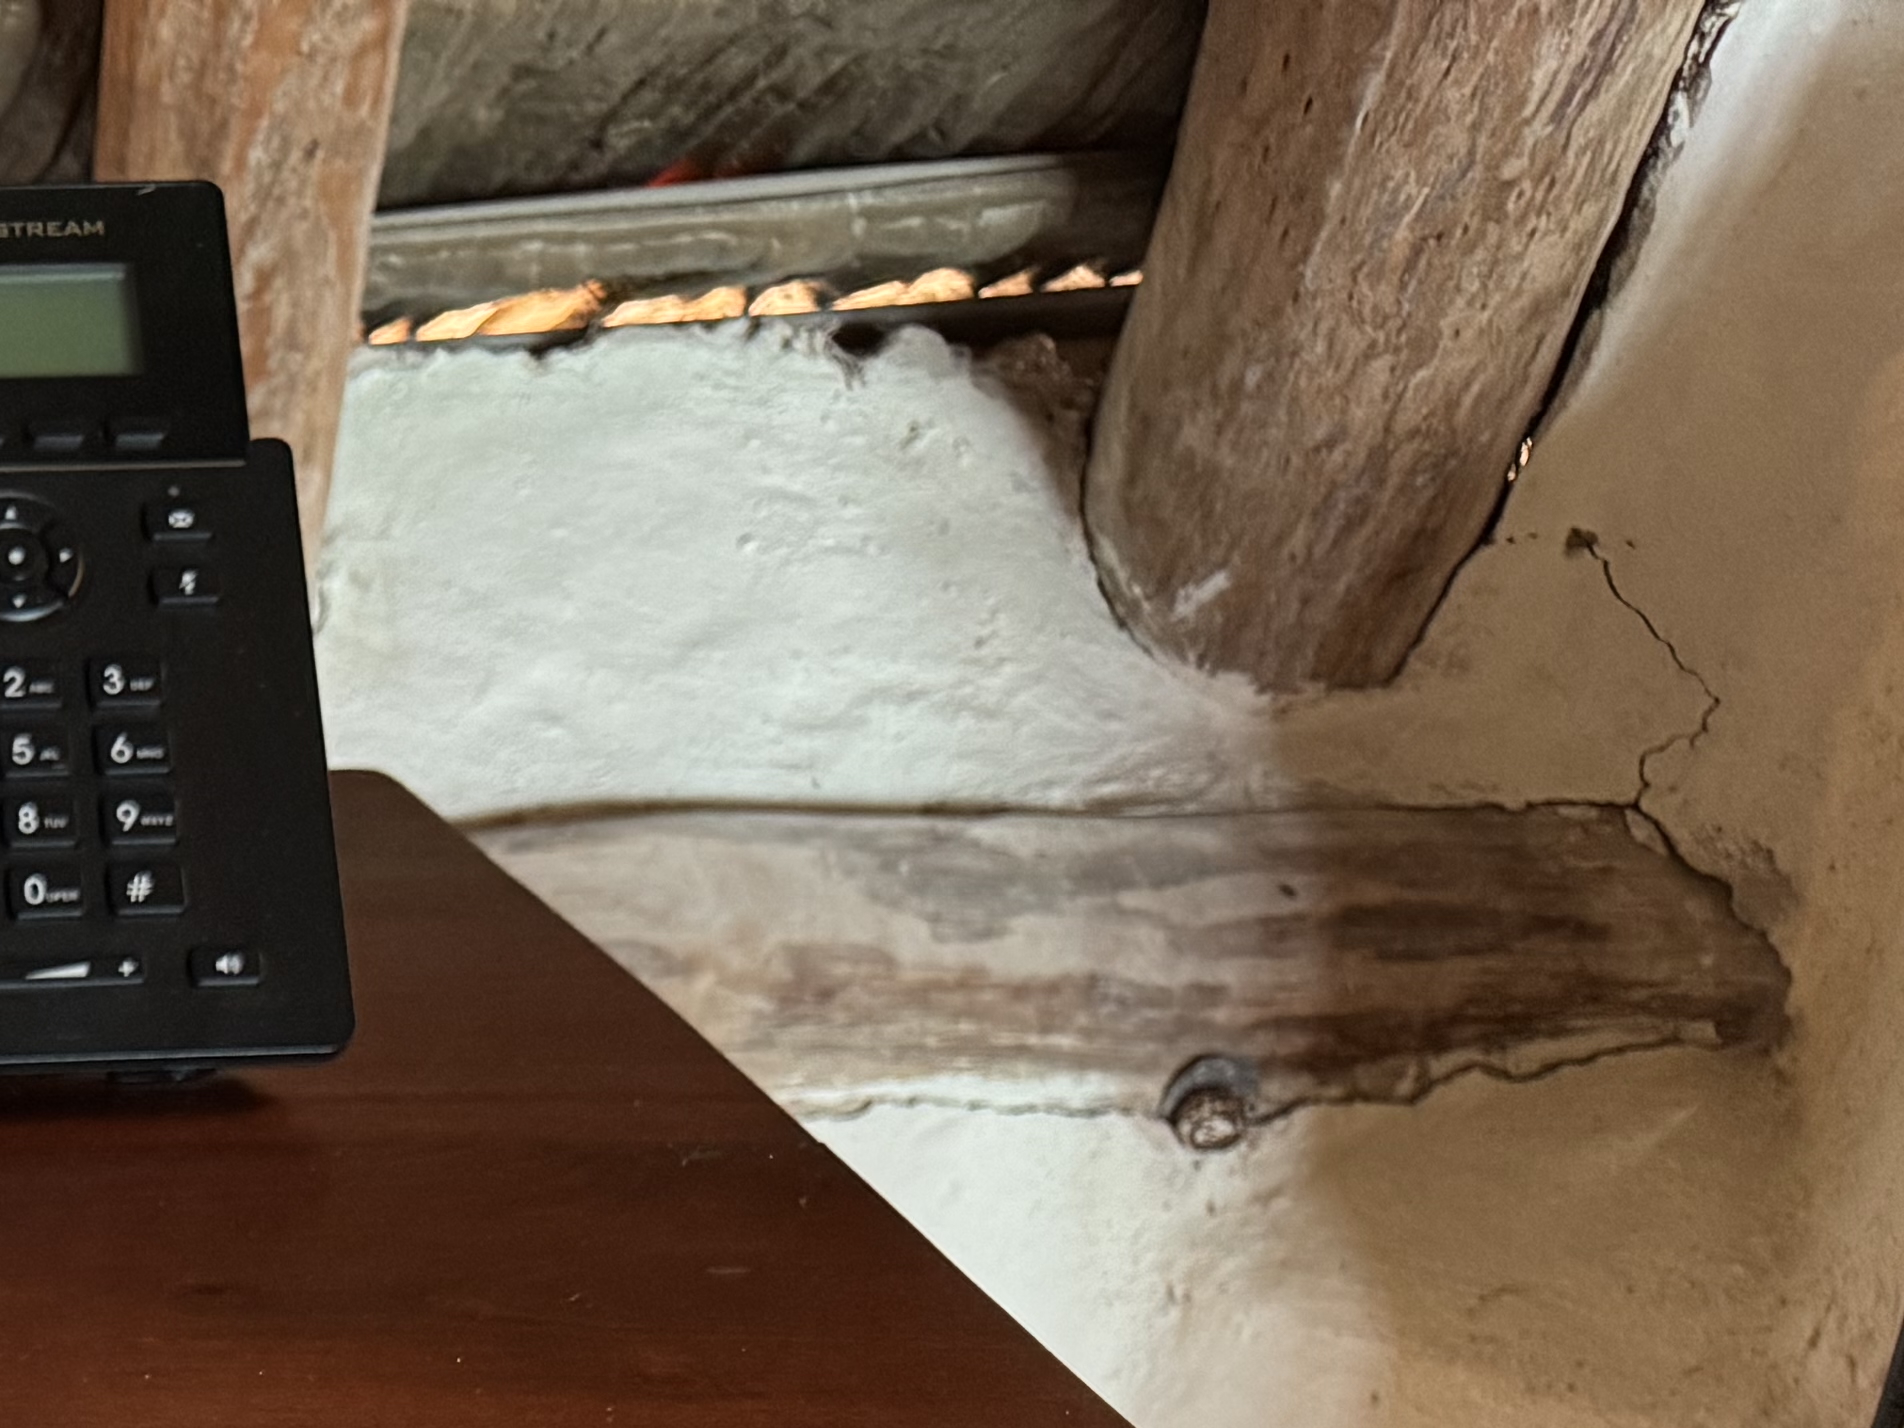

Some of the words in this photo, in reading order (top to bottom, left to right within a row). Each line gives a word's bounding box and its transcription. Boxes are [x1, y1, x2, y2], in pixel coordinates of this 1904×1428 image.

[3, 665, 27, 698] 2
[103, 663, 125, 695] 3
[11, 732, 35, 765] 5
[110, 731, 134, 764] 6
[18, 801, 40, 835] 8
[115, 799, 140, 832] 9
[23, 872, 47, 905] 0
